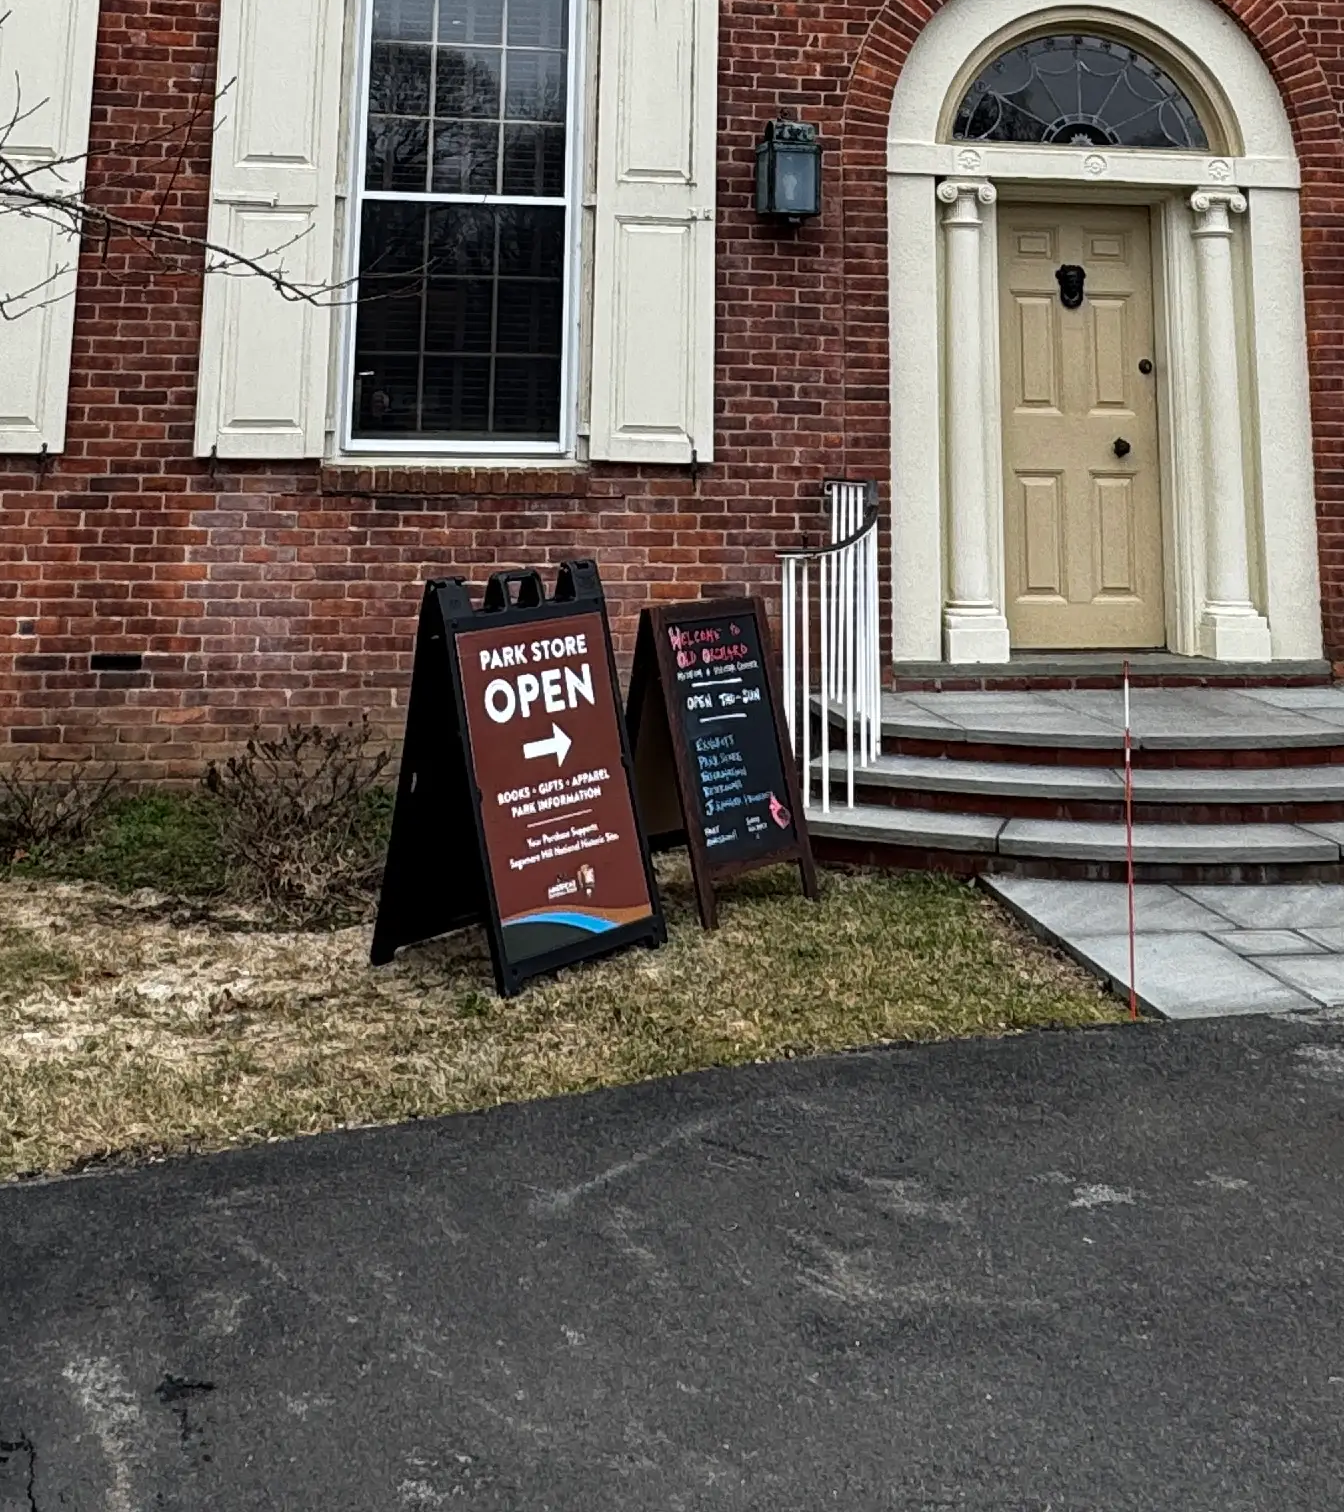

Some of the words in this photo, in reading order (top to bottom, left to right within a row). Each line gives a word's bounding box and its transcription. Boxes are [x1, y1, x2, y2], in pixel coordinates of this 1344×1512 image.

[479, 643, 528, 671] PARK
[531, 633, 588, 662] STORE
[484, 663, 595, 723] OPEN
[687, 693, 712, 710] OPEN
[497, 787, 531, 806] BOOKS
[538, 779, 564, 795] GIFTS
[571, 768, 610, 788] APPAREL
[511, 802, 536, 818] PARK
[537, 785, 602, 812] INFORMATION
